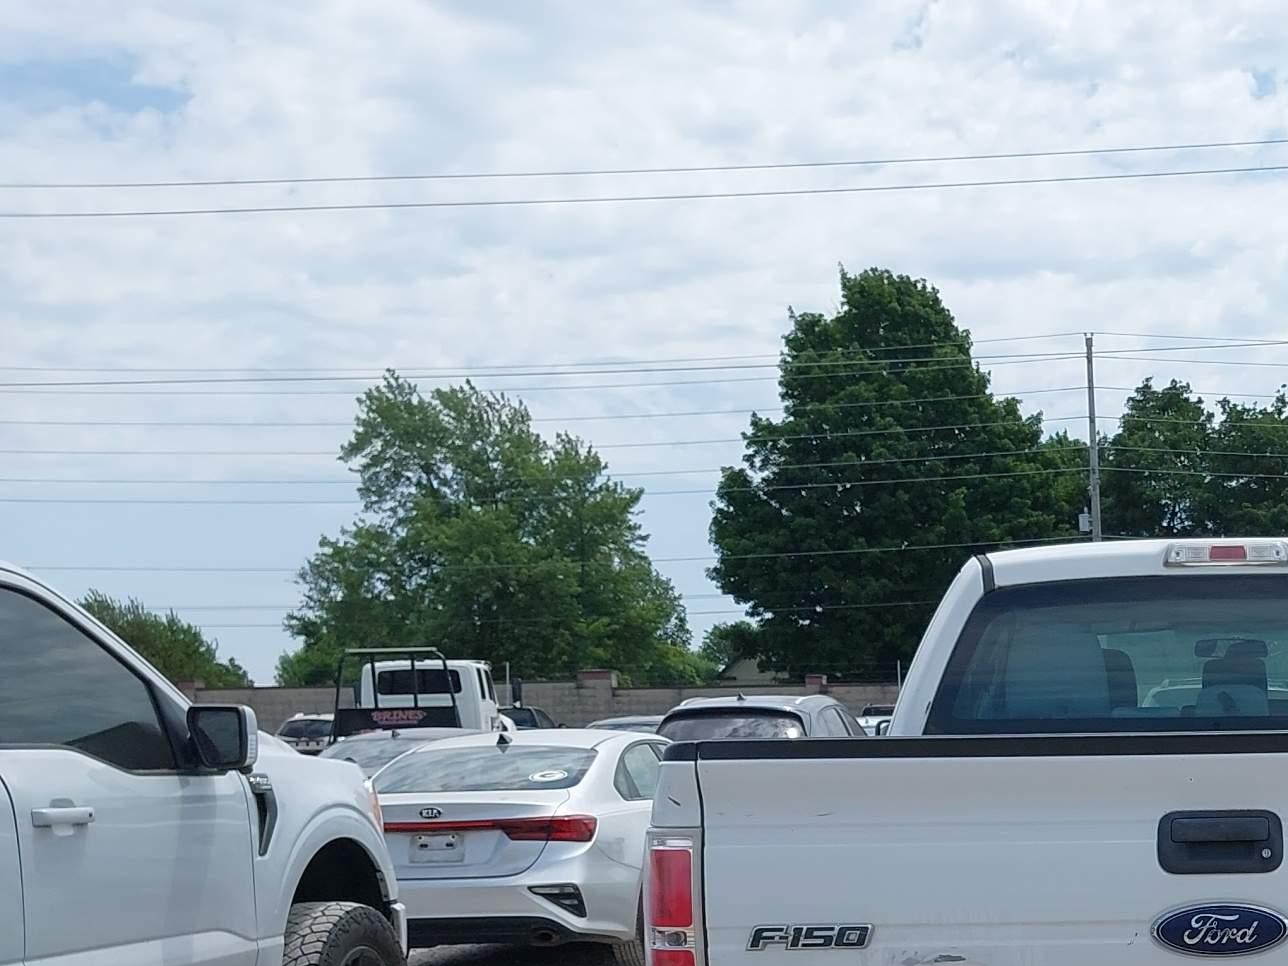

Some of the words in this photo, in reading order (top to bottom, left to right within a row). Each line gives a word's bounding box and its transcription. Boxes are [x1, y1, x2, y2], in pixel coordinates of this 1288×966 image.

[421, 808, 441, 818] KIA
[747, 924, 873, 950] F-150
[1183, 913, 1259, 945] Ford
